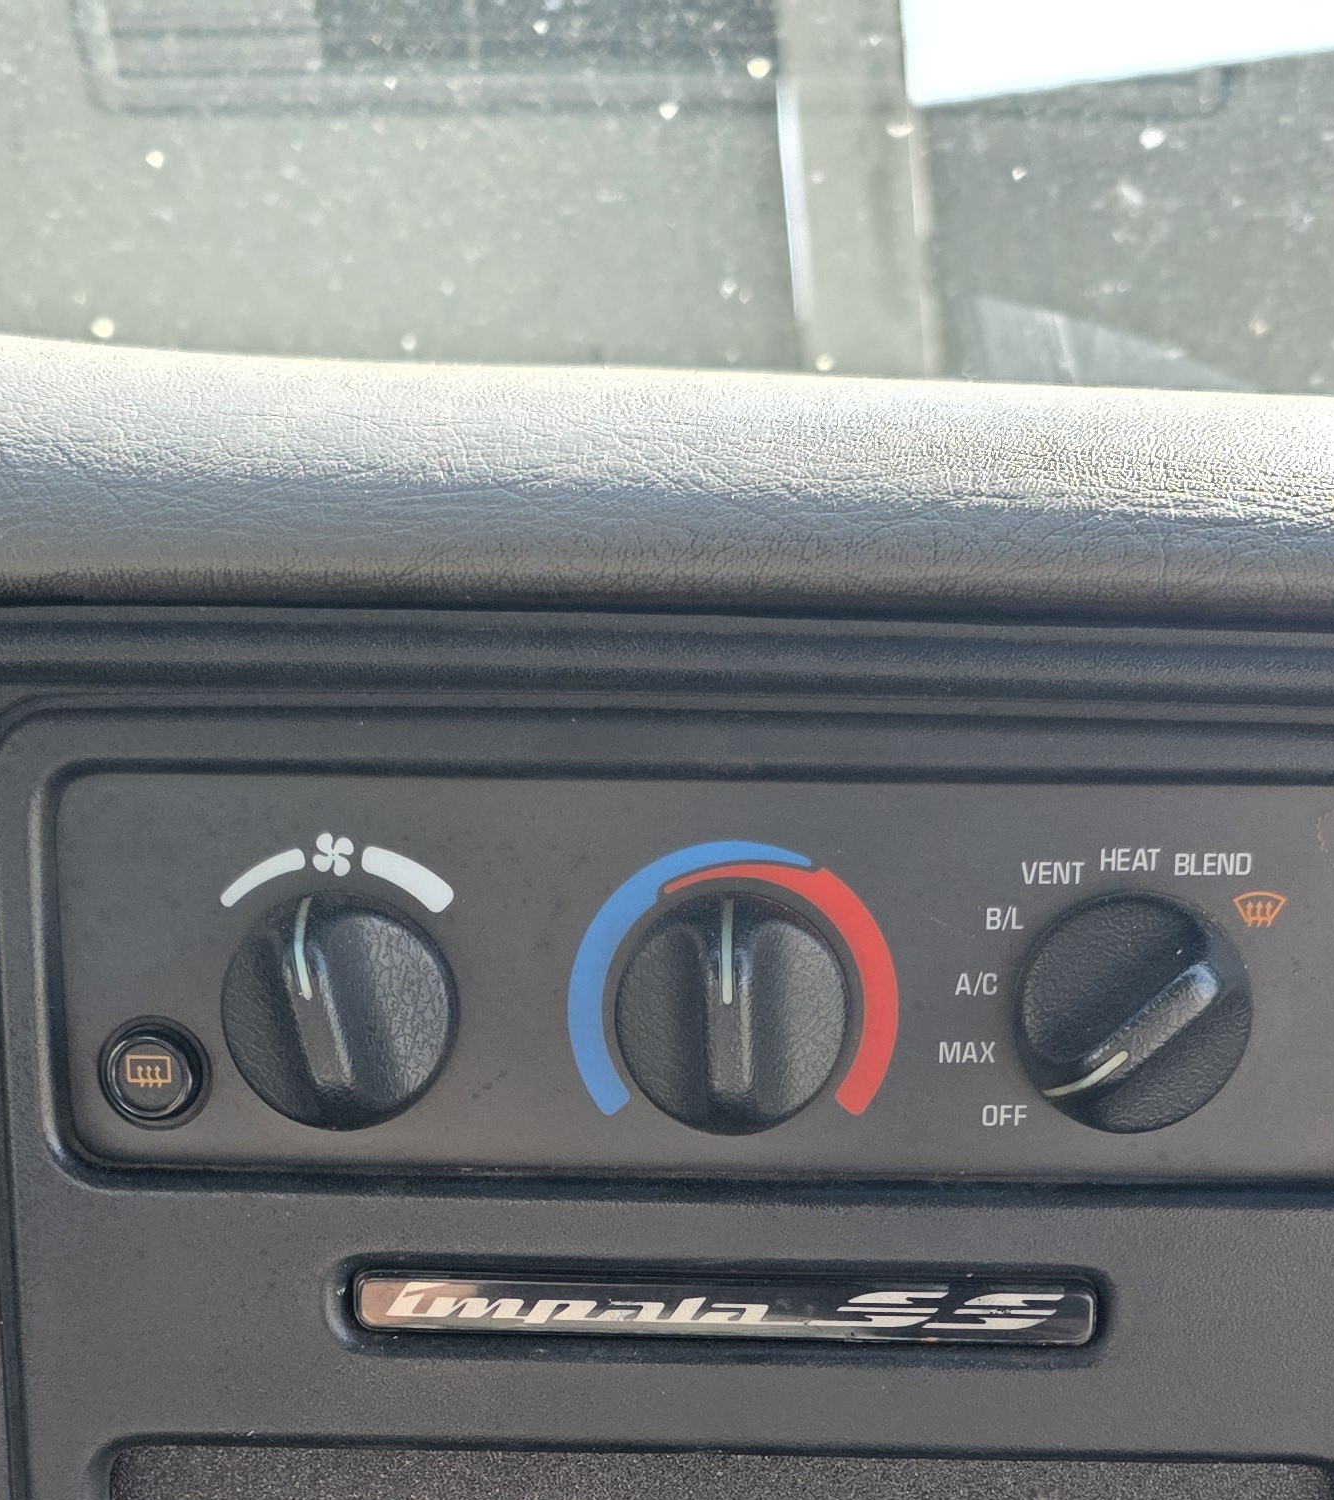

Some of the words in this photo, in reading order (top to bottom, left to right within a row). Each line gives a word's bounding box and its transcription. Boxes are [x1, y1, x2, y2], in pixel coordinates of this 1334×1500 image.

[1021, 861, 1086, 886] VENT
[1099, 847, 1162, 873] HEAT
[1173, 852, 1253, 878] BLEND
[985, 906, 1025, 932] B/L
[954, 972, 999, 997] A/C
[937, 1041, 997, 1065] MAX
[981, 1104, 1028, 1128] OFF
[385, 1280, 775, 1326] Impala
[809, 1284, 1066, 1331] SS
